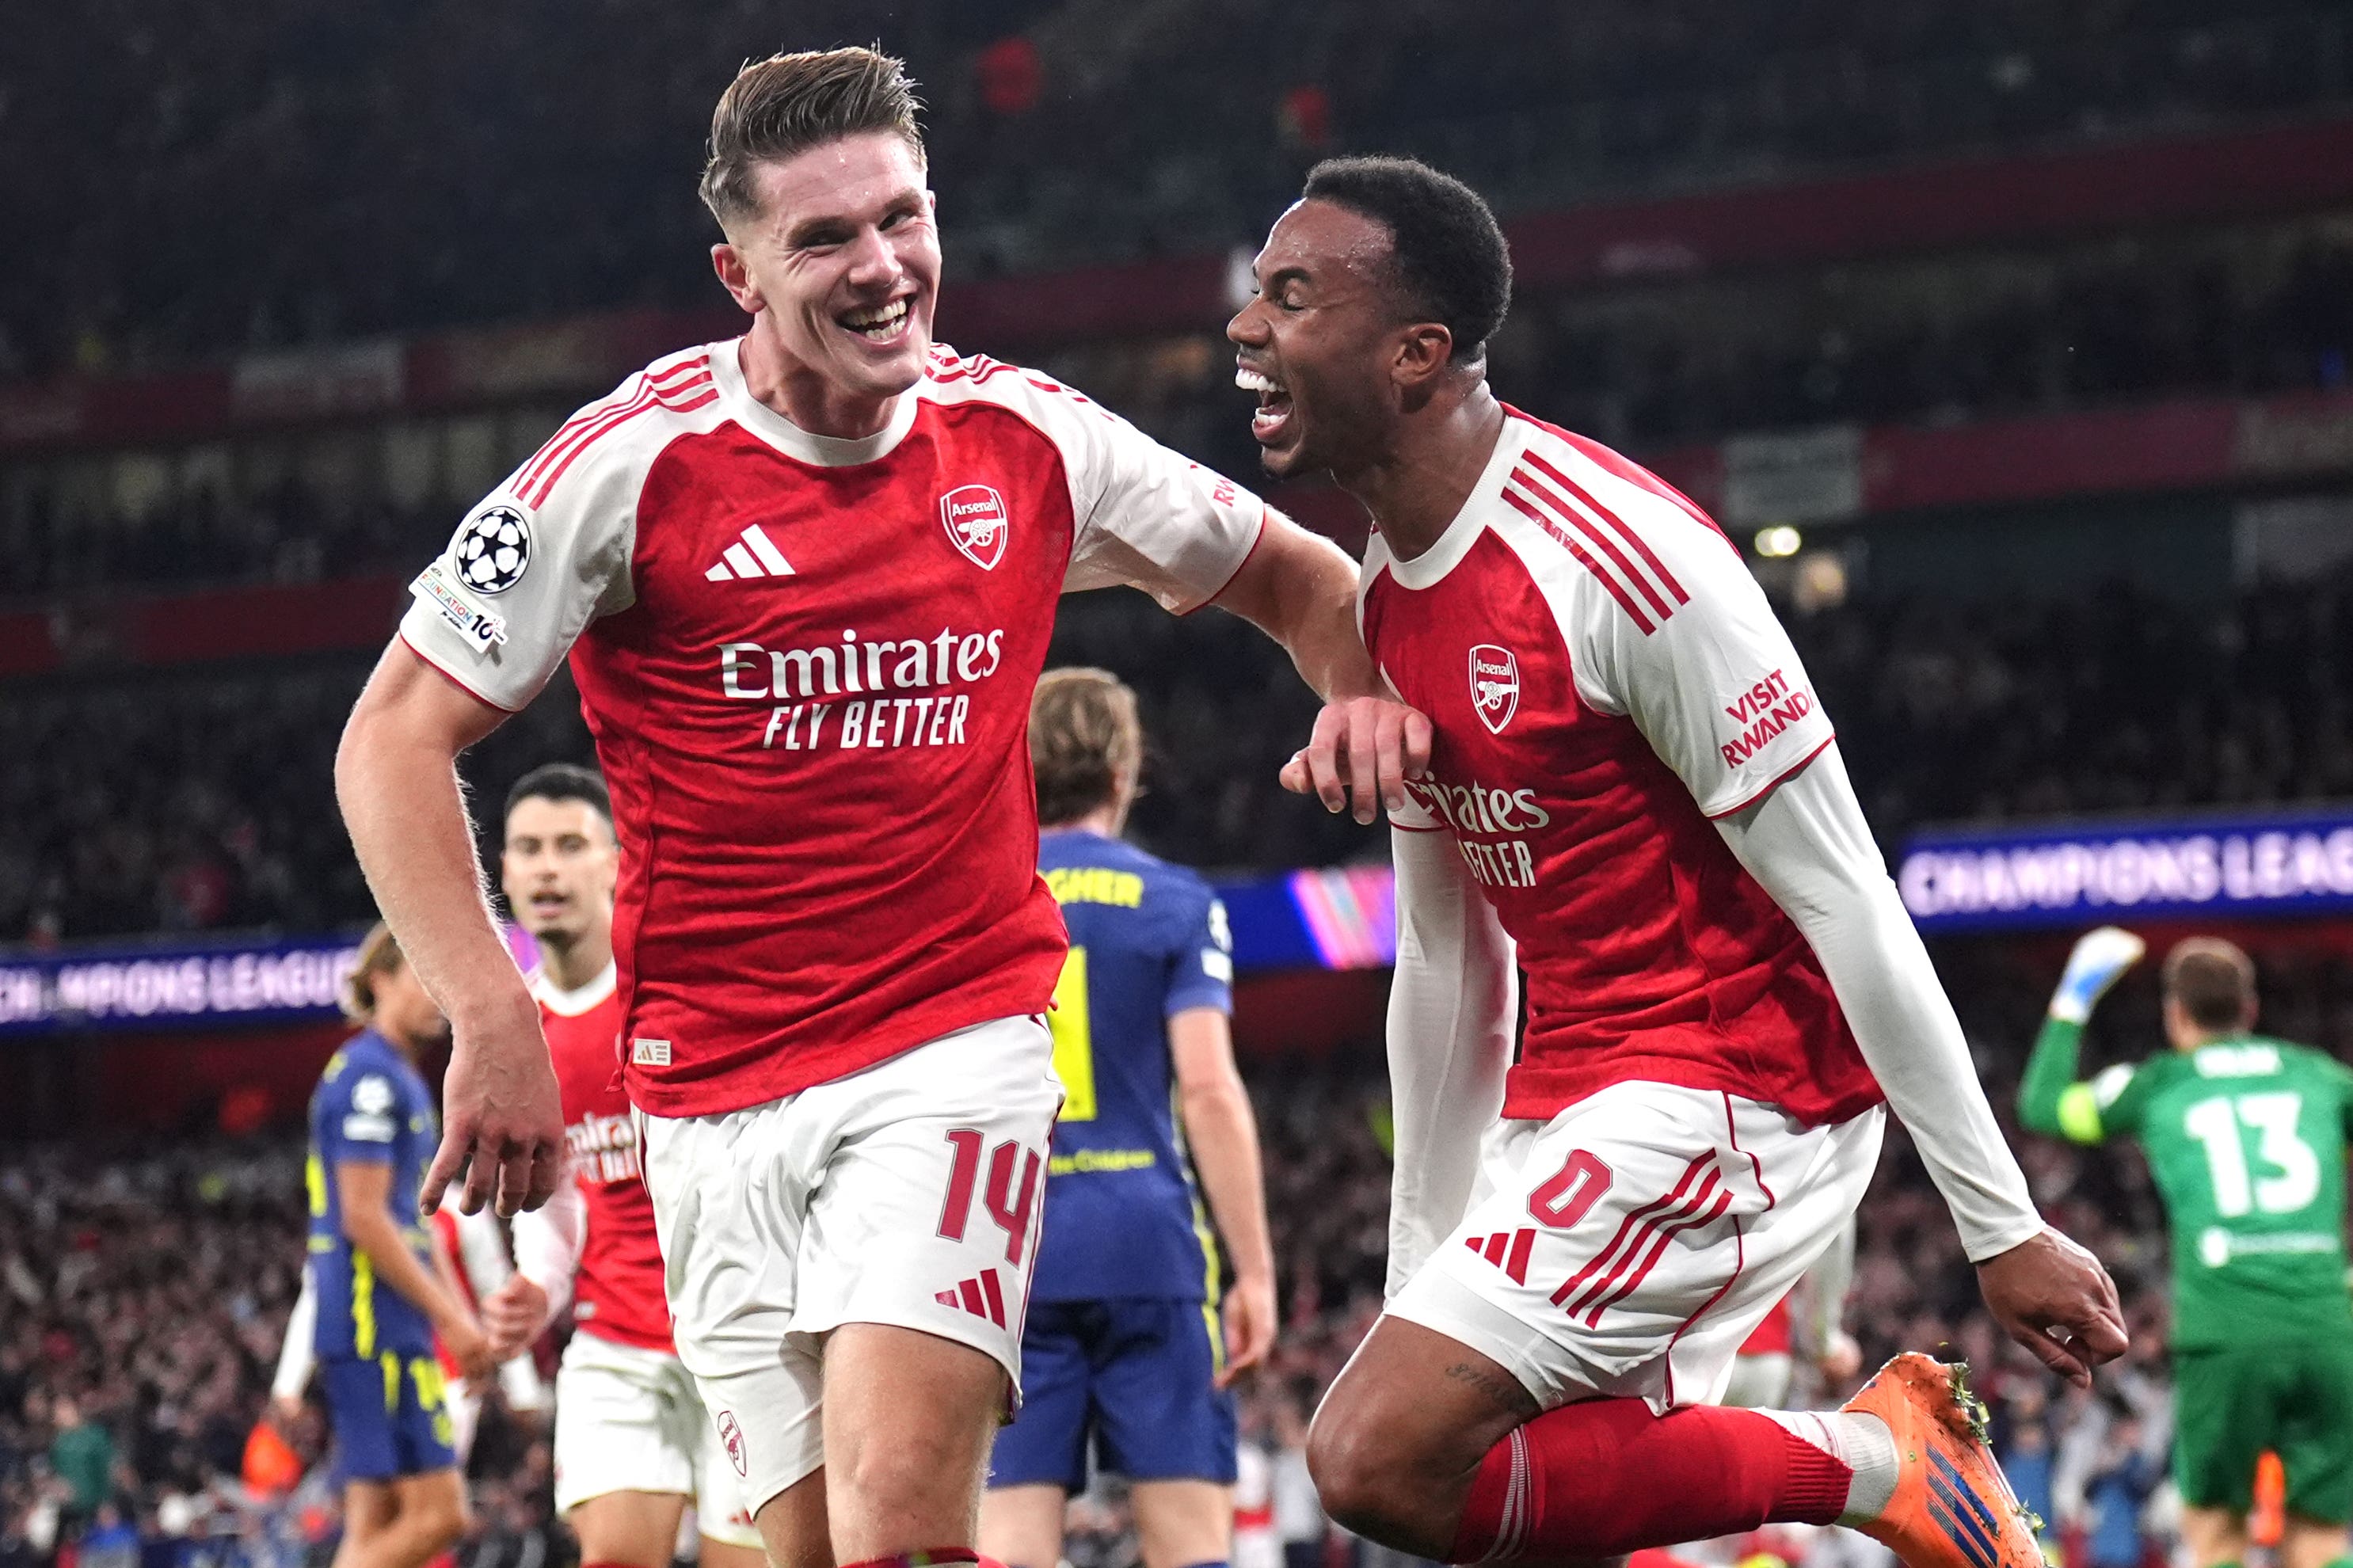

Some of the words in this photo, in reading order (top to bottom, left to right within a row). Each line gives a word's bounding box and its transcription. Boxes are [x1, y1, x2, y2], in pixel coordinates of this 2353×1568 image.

[952, 498, 996, 517] Arsenal
[420, 573, 473, 622] FOUNDATION
[716, 626, 1003, 698] Emirates
[1476, 659, 1510, 676] Arsenal
[763, 703, 832, 750] FLY
[840, 695, 969, 748] BETTER
[1725, 668, 1789, 725] VISIT
[1403, 771, 1550, 832] irates
[1456, 839, 1536, 887] ETTER
[1901, 835, 2220, 916] CHAMPIONS
[0, 957, 207, 1022] HMPIONS
[2184, 1092, 2321, 1218] 13
[935, 1128, 1041, 1271] 14
